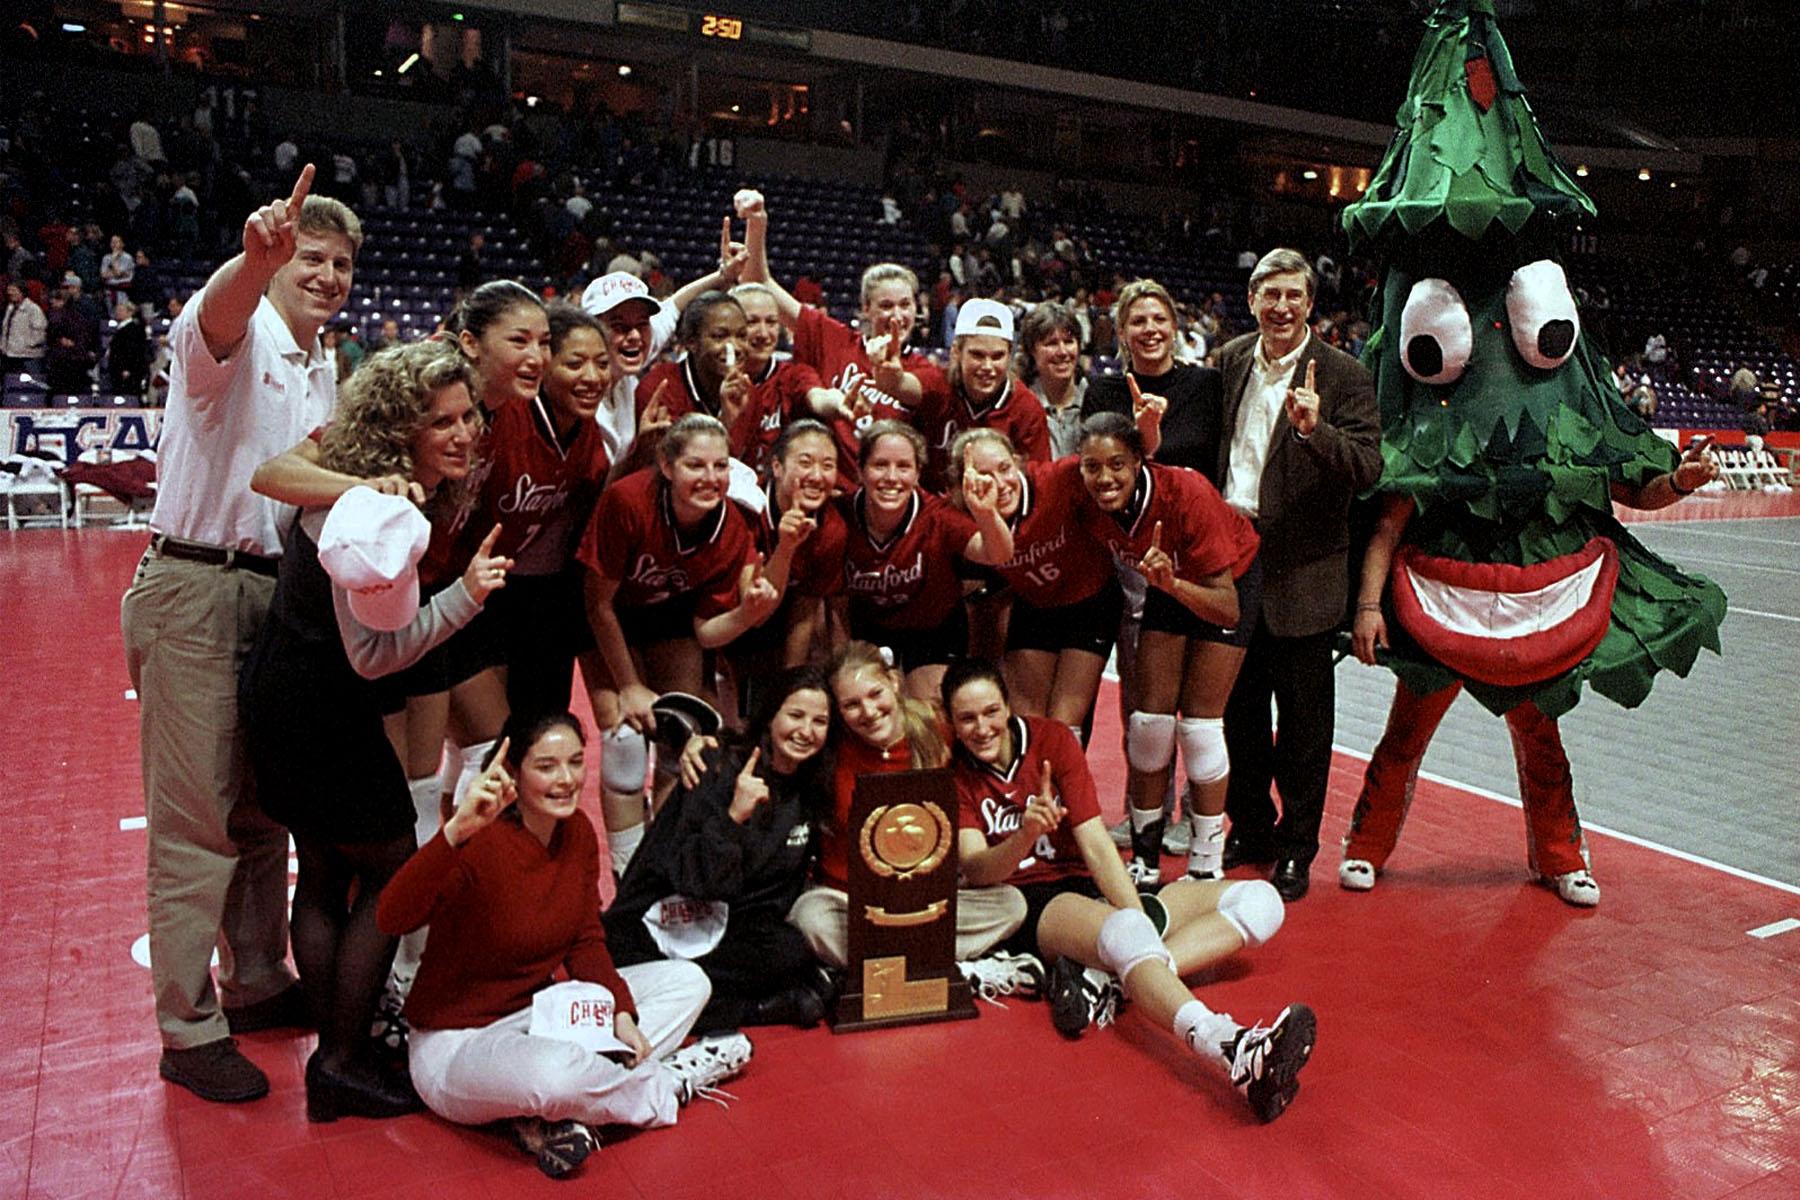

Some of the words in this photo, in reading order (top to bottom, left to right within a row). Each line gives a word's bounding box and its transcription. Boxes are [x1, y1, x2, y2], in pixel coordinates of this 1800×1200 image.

[12, 412, 165, 467] NCA
[516, 523, 542, 553] 7
[997, 525, 1066, 570] anford
[845, 551, 923, 594] Stanford
[1024, 565, 1061, 586] 16
